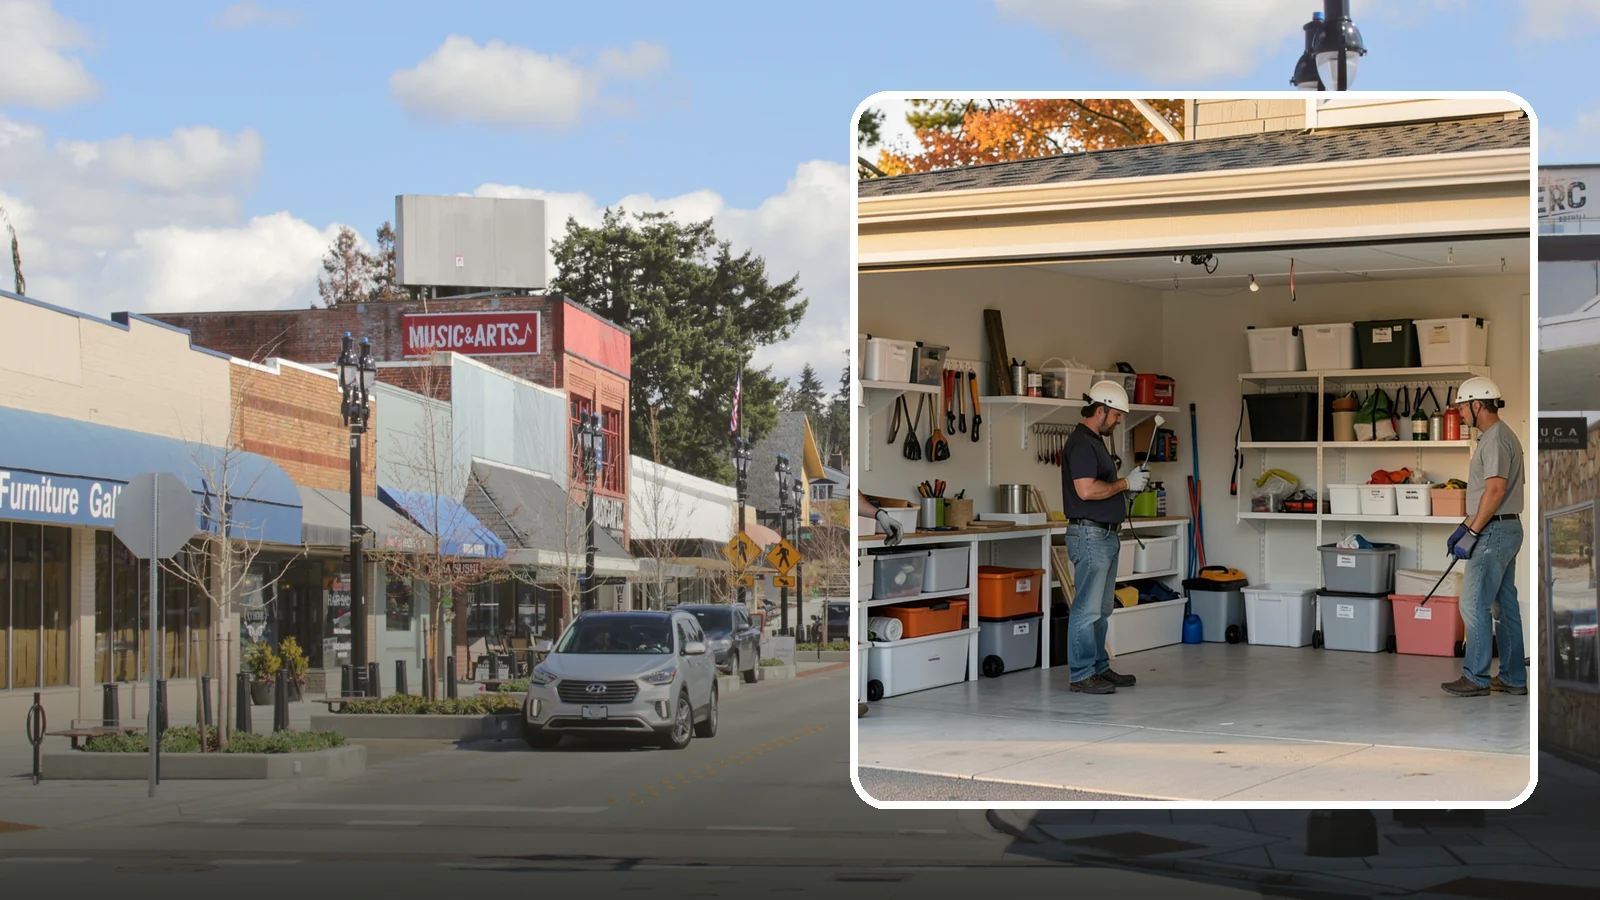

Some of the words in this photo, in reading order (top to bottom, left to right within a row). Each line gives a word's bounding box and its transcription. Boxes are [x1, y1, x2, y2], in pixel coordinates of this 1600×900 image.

[409, 323, 519, 349] MUSIC&ARTS
[0, 472, 79, 515] Furniture
[89, 482, 122, 519] Gal
